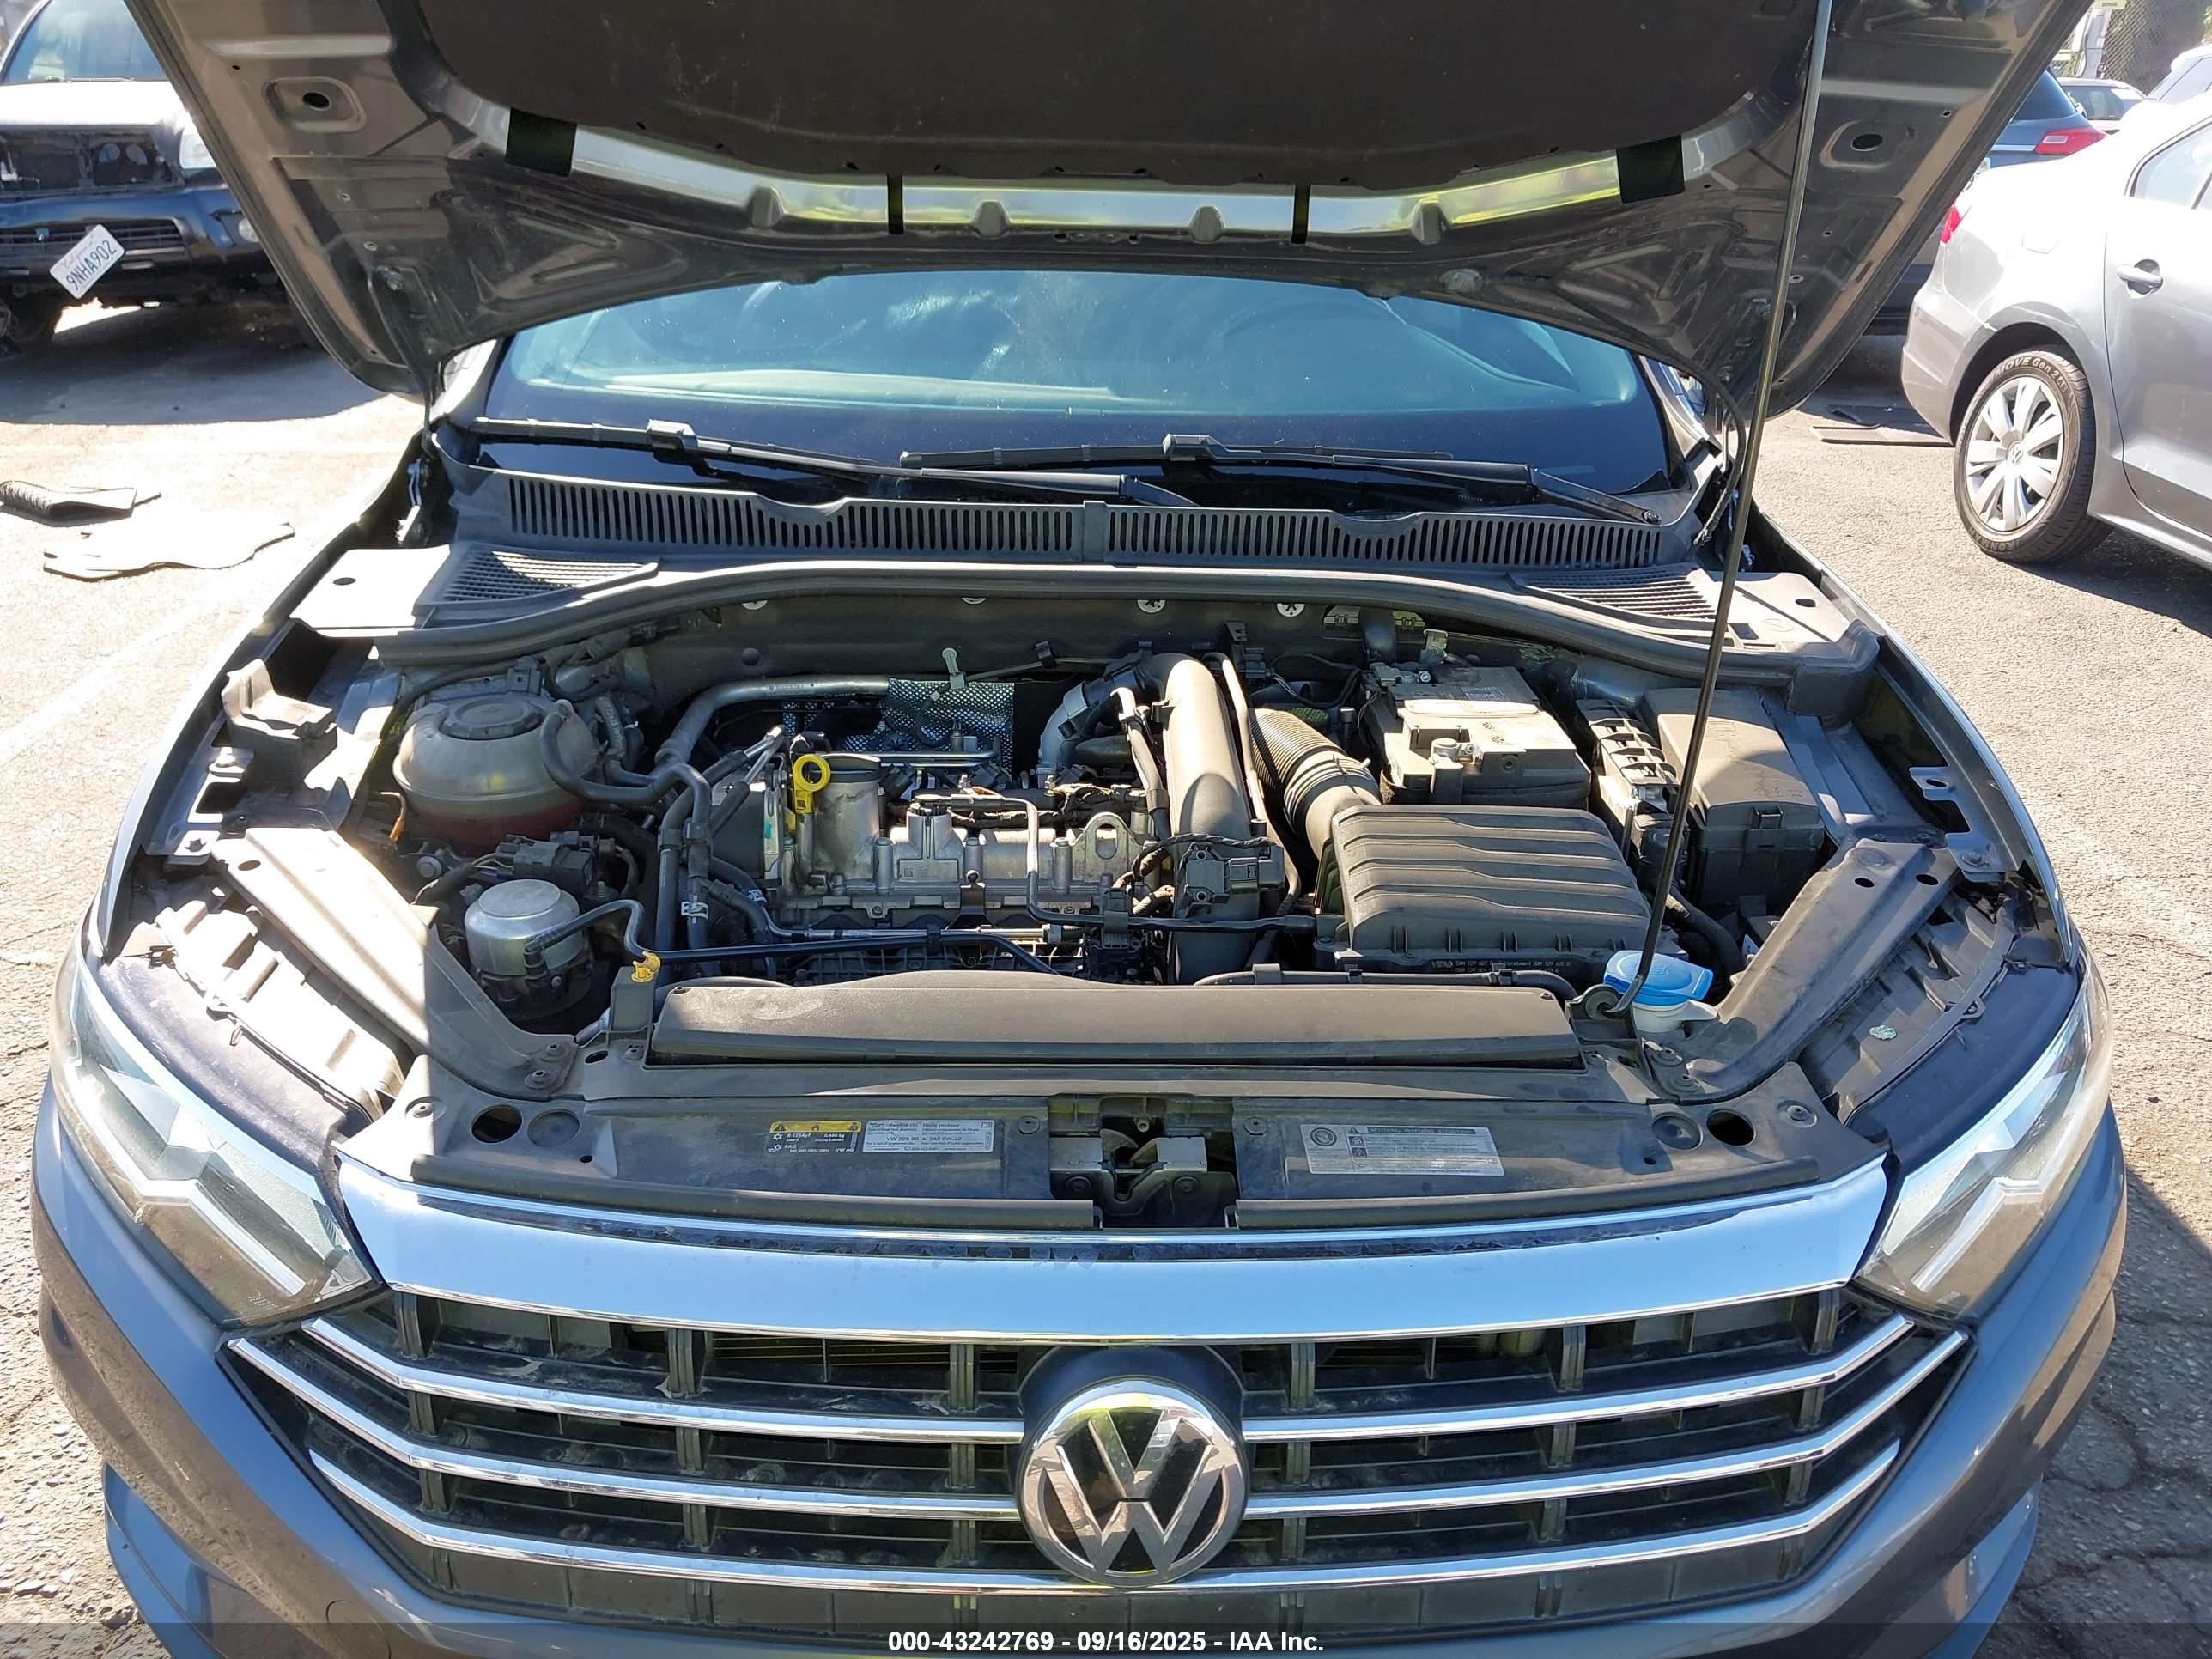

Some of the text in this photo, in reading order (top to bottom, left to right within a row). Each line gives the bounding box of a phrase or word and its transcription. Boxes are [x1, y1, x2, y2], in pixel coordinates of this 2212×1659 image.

[65, 240, 117, 290] 9NHA902
[2032, 357, 2052, 374] Gen
[2051, 370, 2059, 380] 2
[1025, 1384, 1242, 1582] VW
